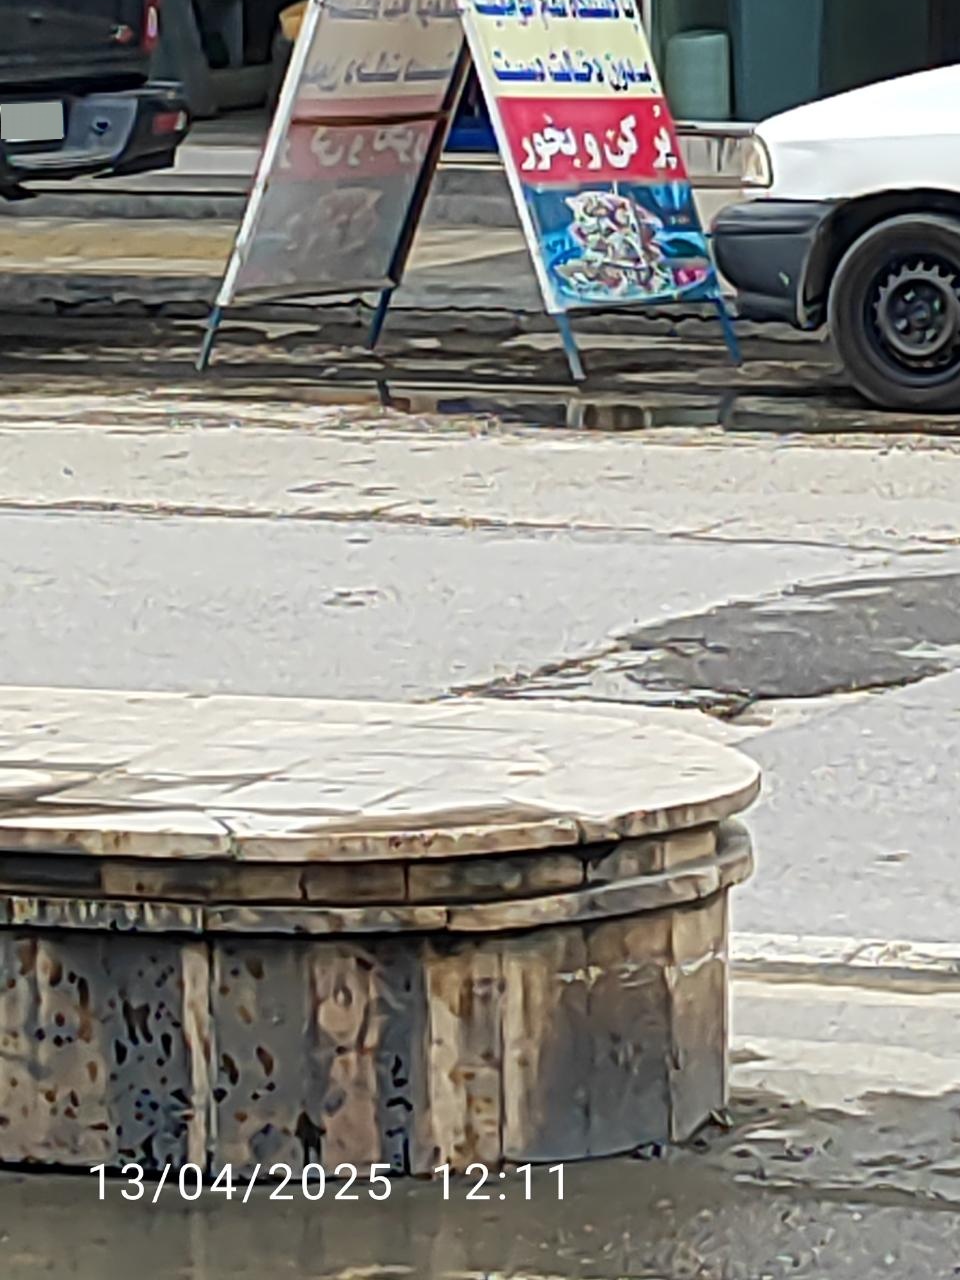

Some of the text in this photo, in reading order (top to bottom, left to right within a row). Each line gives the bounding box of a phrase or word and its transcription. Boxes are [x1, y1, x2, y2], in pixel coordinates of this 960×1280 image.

[521, 113, 583, 170] بخور
[583, 132, 603, 170] و
[604, 114, 639, 169] کن
